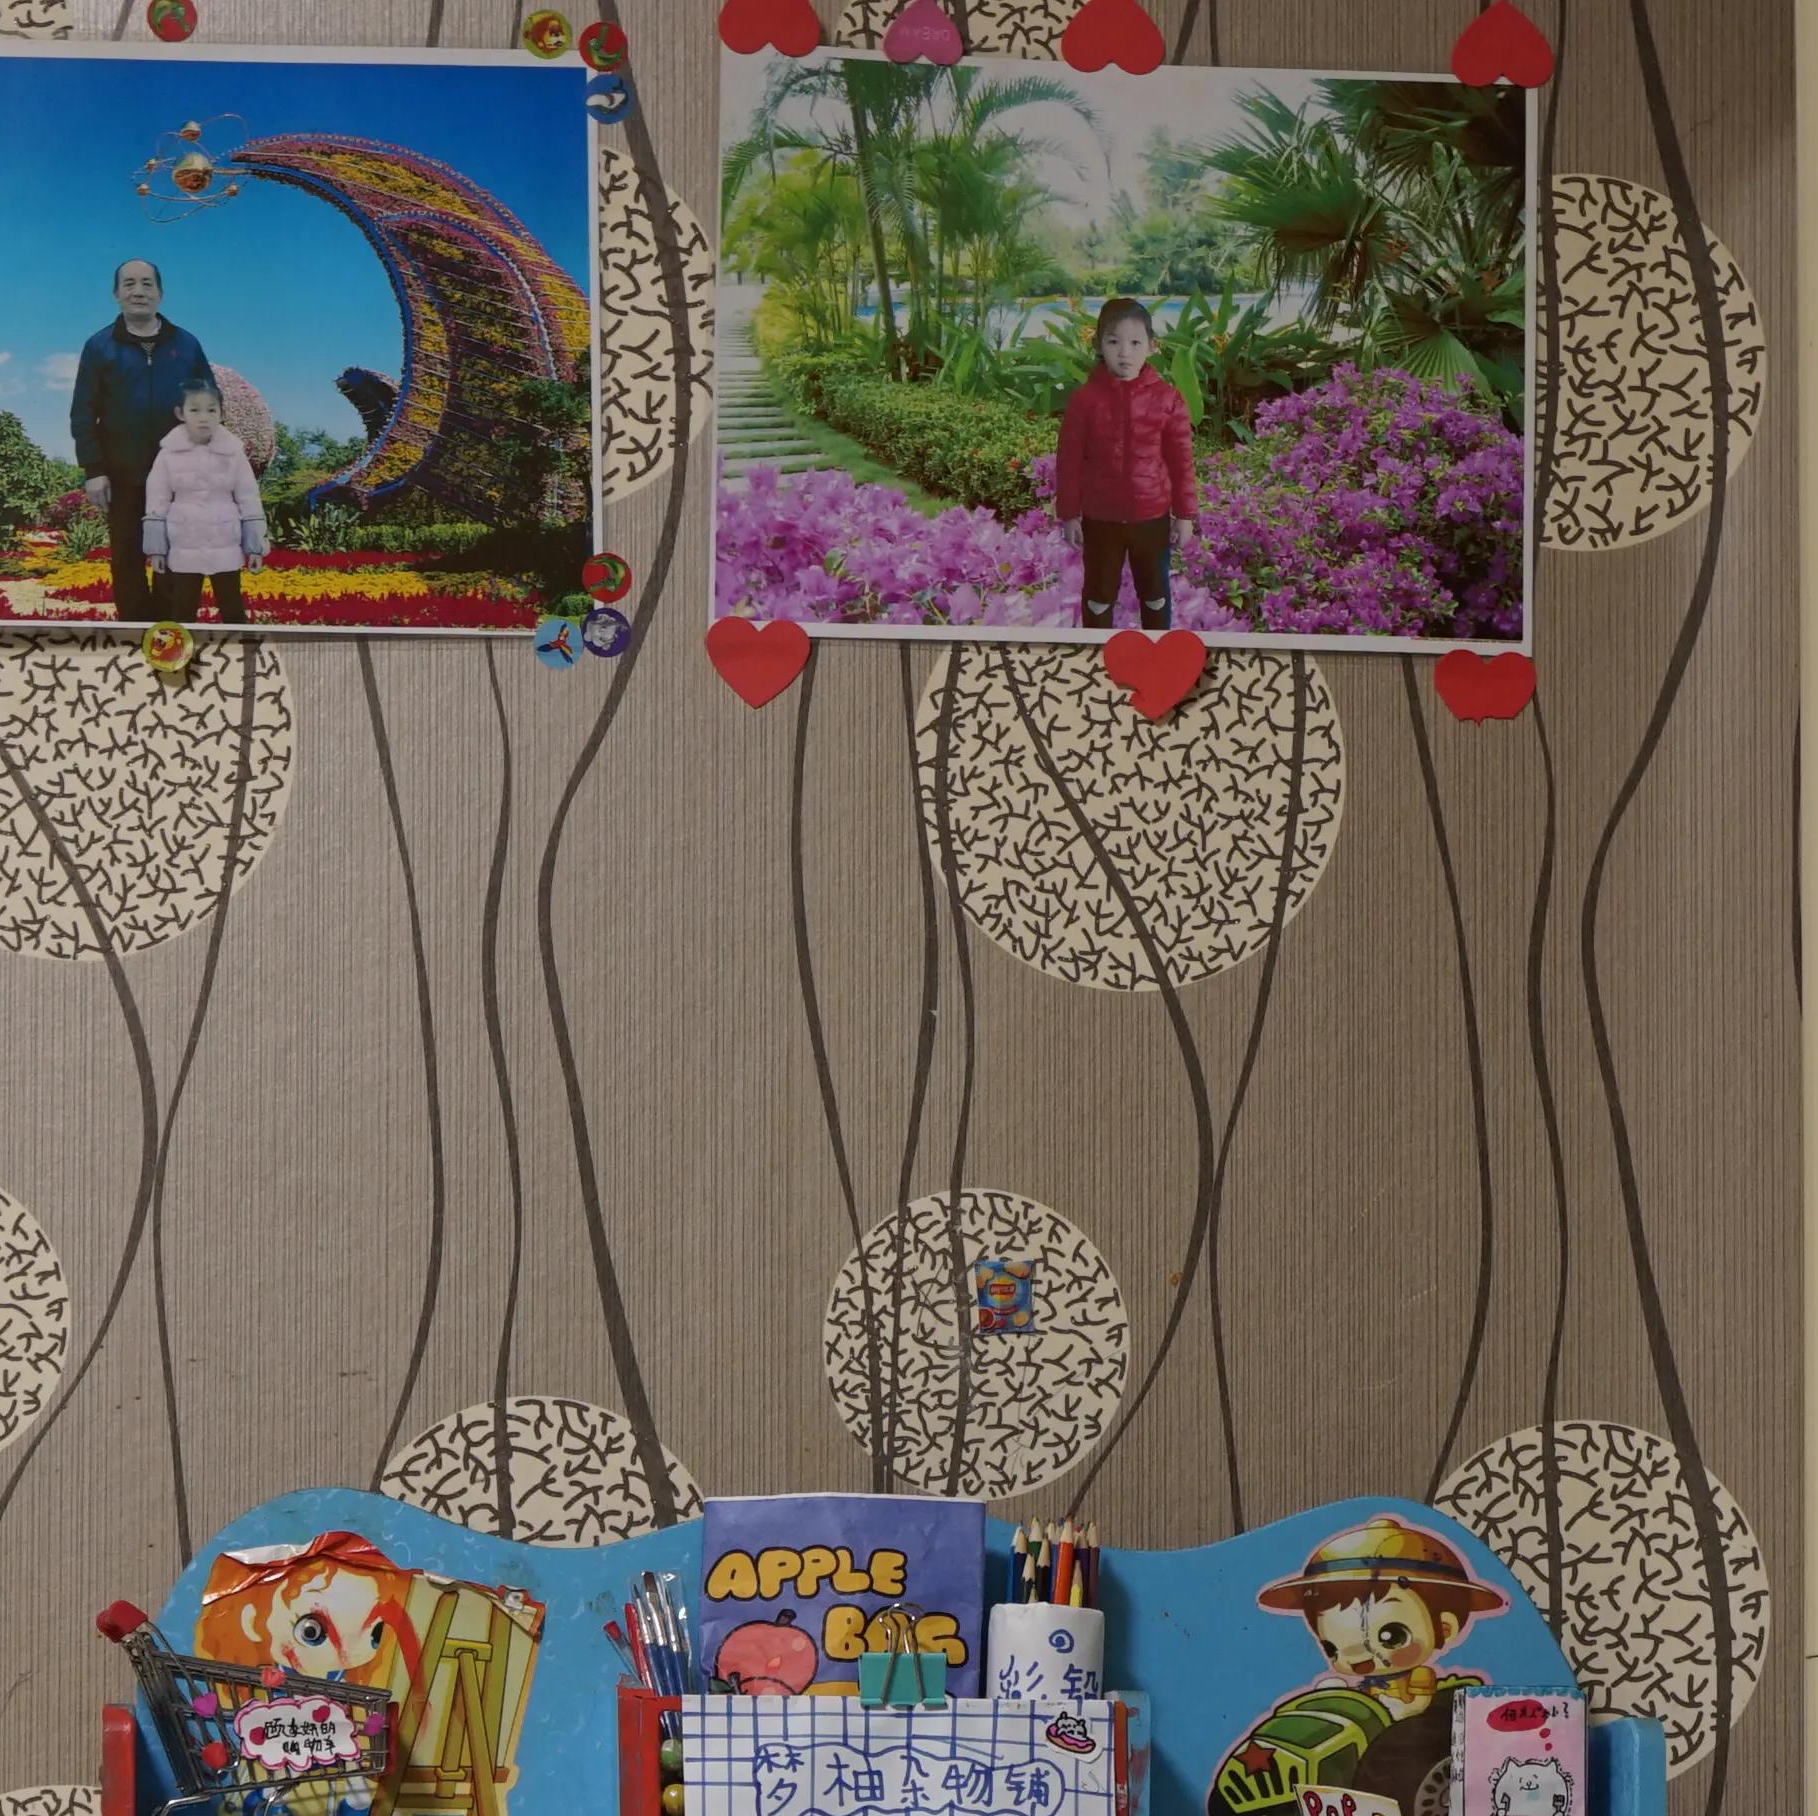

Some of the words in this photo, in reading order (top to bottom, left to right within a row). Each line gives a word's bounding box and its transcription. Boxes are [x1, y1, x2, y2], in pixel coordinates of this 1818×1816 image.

[705, 1545, 908, 1602] APPLE
[996, 1655, 1100, 1700] 彩铅
[756, 1745, 1051, 1816] 梦柚杂物铺
